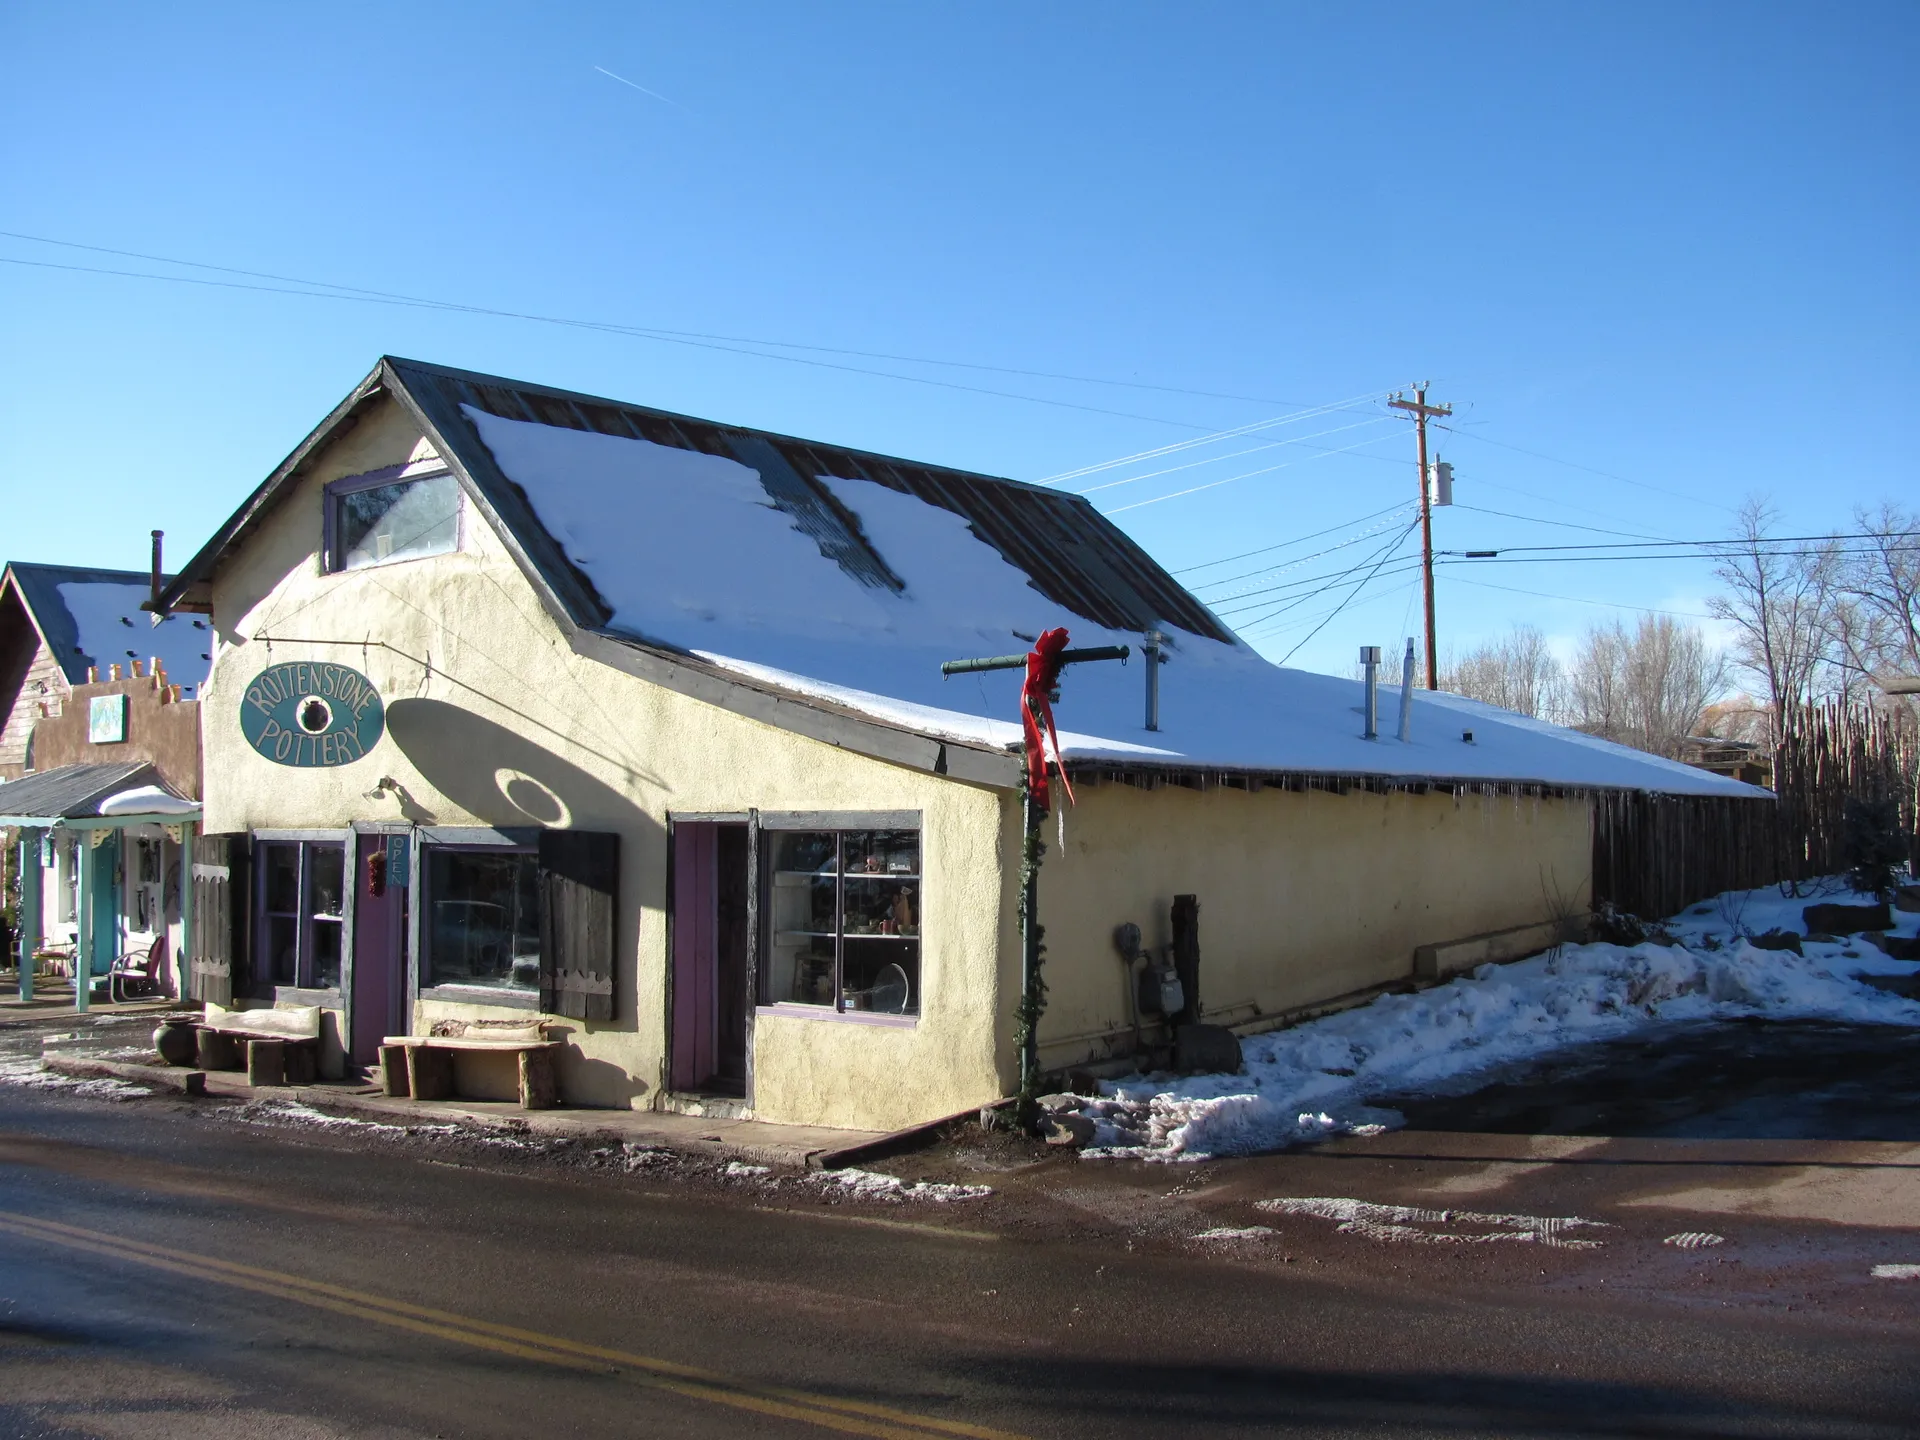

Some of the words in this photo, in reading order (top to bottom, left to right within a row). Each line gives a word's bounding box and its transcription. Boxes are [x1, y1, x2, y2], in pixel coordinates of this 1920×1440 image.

[246, 663, 378, 721] ROTTENSTONE
[255, 718, 365, 766] POTTERY
[392, 837, 405, 885] OPEN
